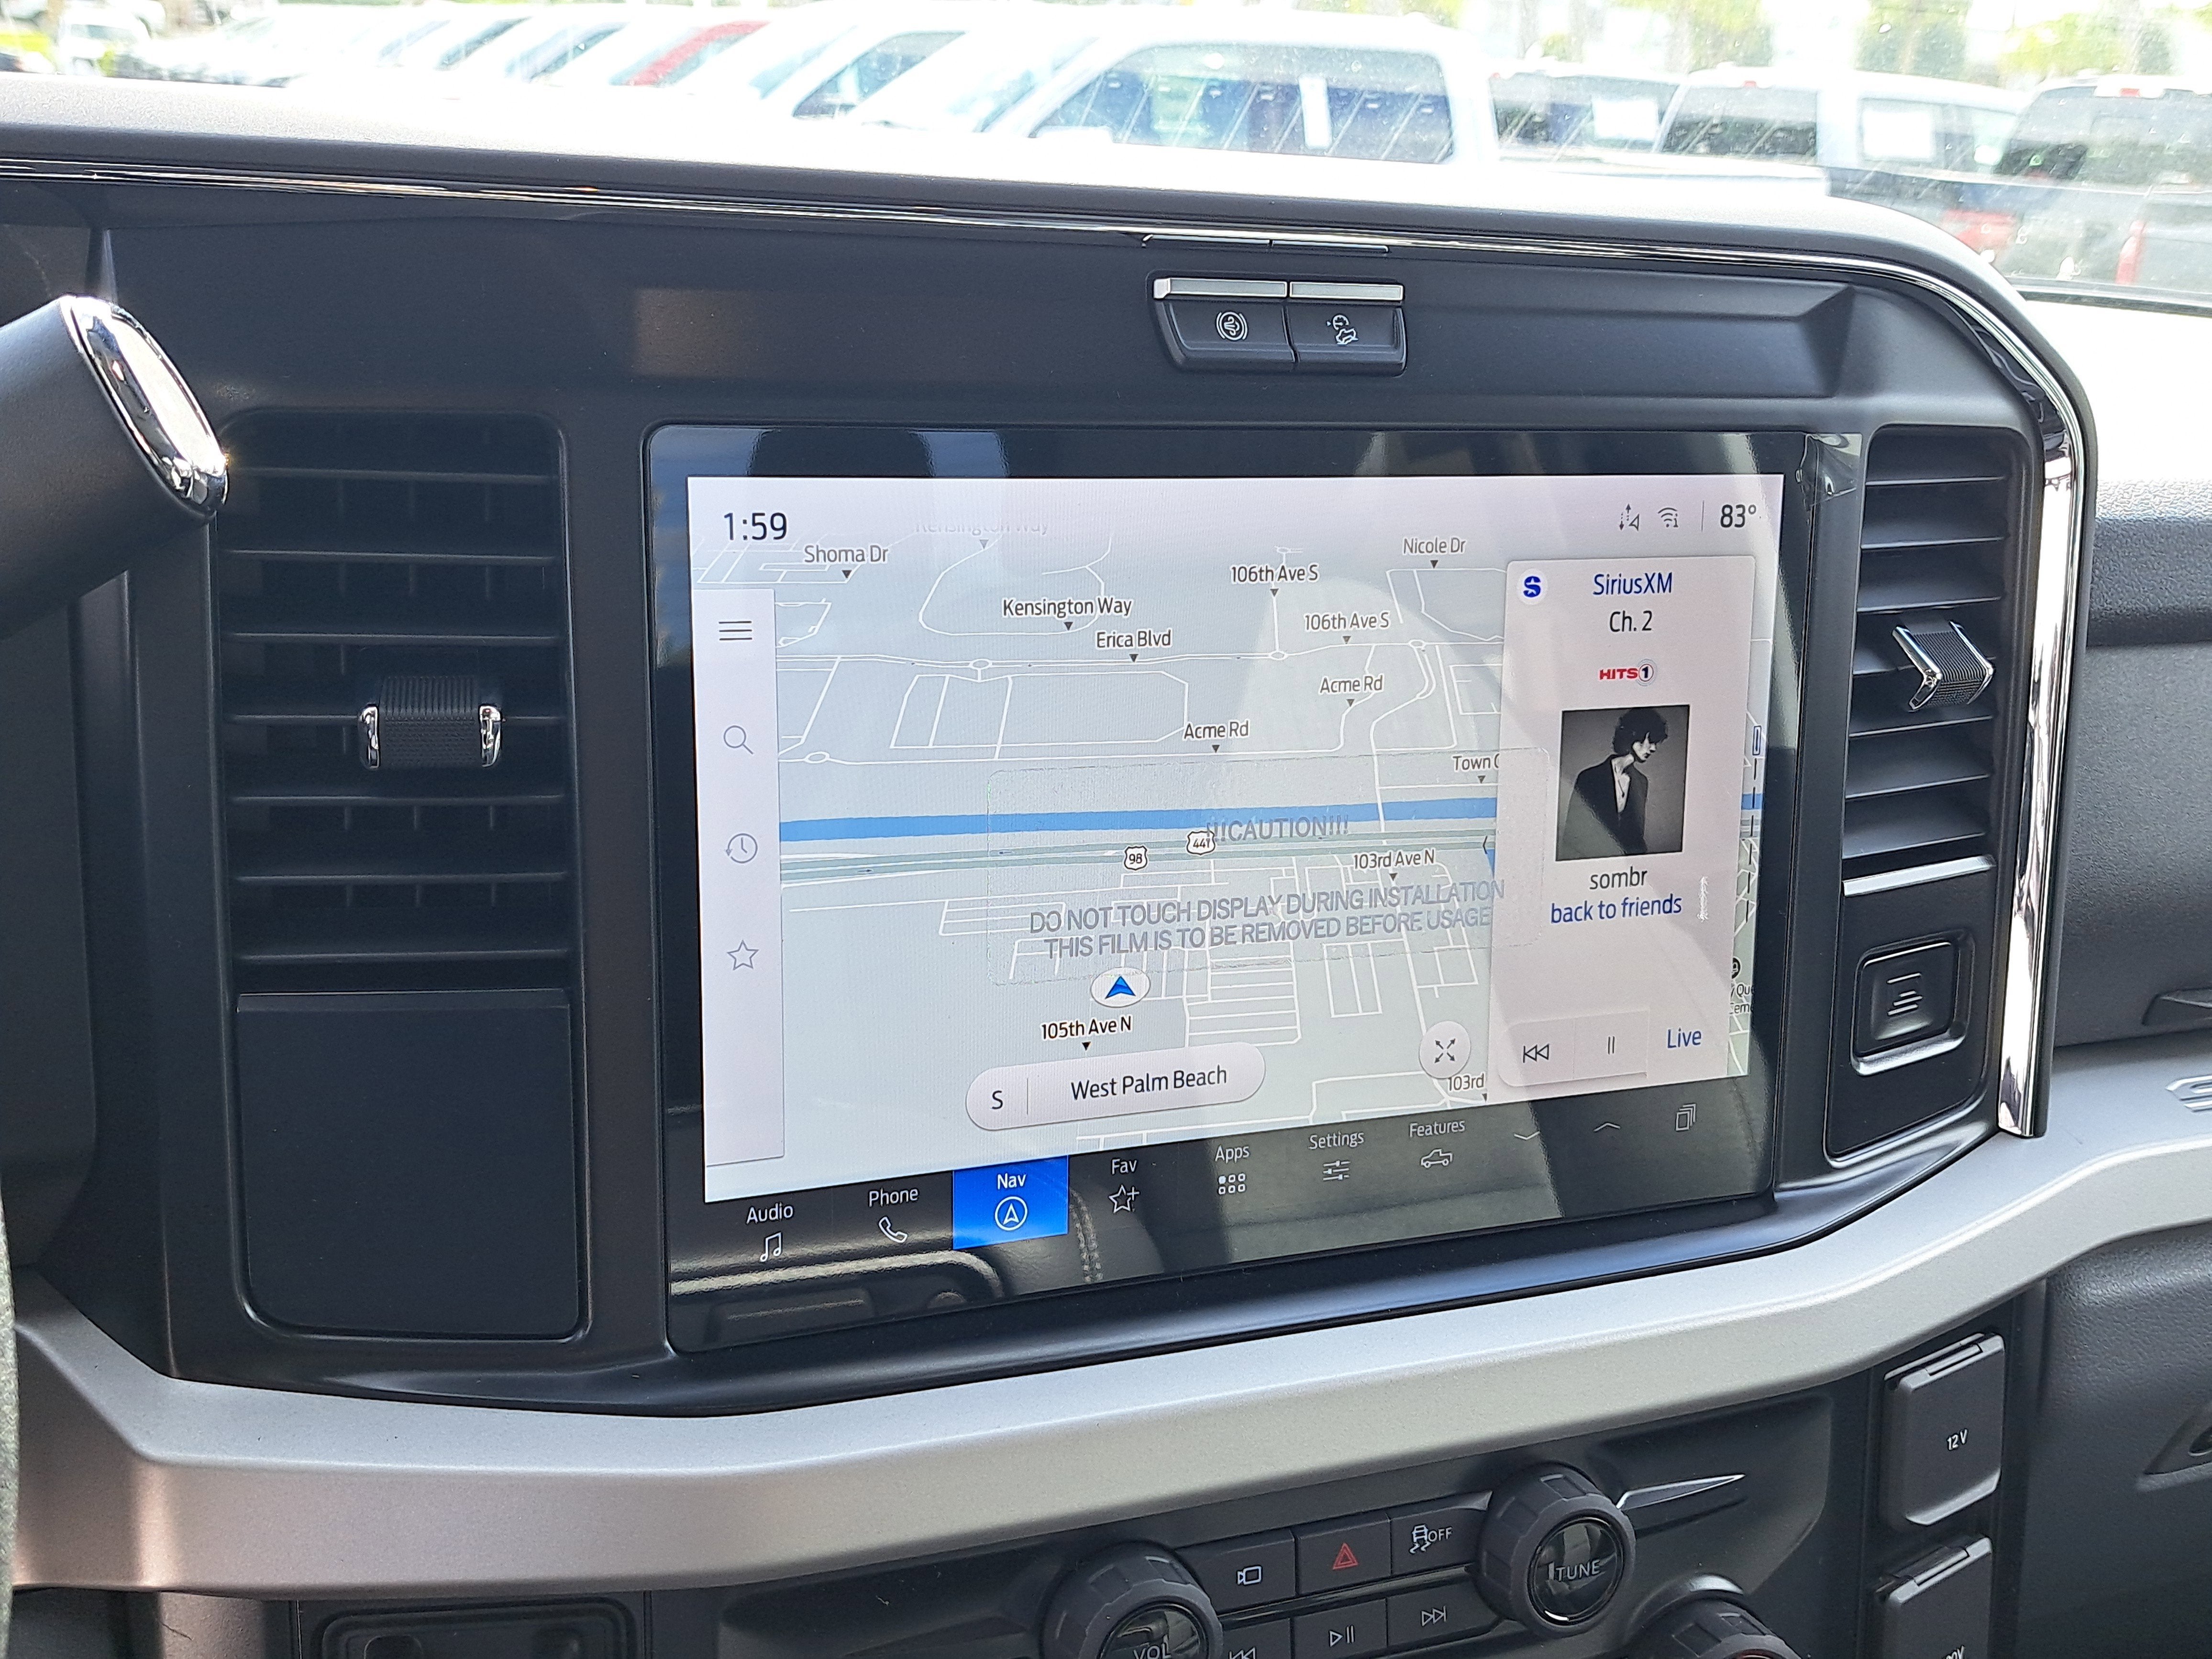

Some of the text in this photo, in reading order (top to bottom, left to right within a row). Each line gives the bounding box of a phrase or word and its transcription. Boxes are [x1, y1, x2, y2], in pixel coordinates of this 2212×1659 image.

[723, 512, 787, 541] 1:59
[804, 546, 888, 563] Shoma Dr
[1404, 539, 1466, 554] Nicole Dr
[1232, 565, 1318, 582] 106th Ave S
[1593, 572, 1672, 595] SiriusXM
[1003, 597, 1132, 619] Kensington Way
[1305, 613, 1389, 630] 106th Ave S
[1610, 610, 1652, 632] Ch. 2
[1097, 631, 1171, 648] Erica Blvd
[1320, 675, 1383, 693] Acme Rd
[1184, 721, 1249, 739] Acme Rd
[1453, 755, 1490, 770] Town
[1193, 837, 1210, 849] 441
[1129, 853, 1142, 864] 98
[1354, 849, 1434, 869] 103rd Ave N
[1590, 867, 1648, 890] sombr
[1030, 879, 1504, 933] DO NOT TOUCH DISPLAY DURING INSTALLATION
[1550, 894, 1682, 923] back to friends
[1043, 907, 1492, 959] THIS FILM IS TO BE REMOVED BEFORE USAGE
[1041, 1017, 1131, 1040] 105th Ave N
[1667, 1028, 1702, 1048] Live
[1071, 1065, 1227, 1100] West Palm Beach
[1448, 1074, 1484, 1091] 103rd
[992, 1091, 1003, 1109] S
[1409, 1119, 1465, 1138] Features
[1309, 1130, 1364, 1150] Settings
[1215, 1146, 1250, 1162] Apps
[1111, 1159, 1137, 1175] Fav
[997, 1173, 1026, 1189] Nav
[868, 1187, 918, 1207] Phone
[746, 1203, 793, 1223] Audio
[1947, 1429, 1968, 1451] 12V
[1428, 1527, 1452, 1541] OFF
[1556, 1561, 1601, 1580] TUNE
[1133, 1642, 1172, 1659] VOL
